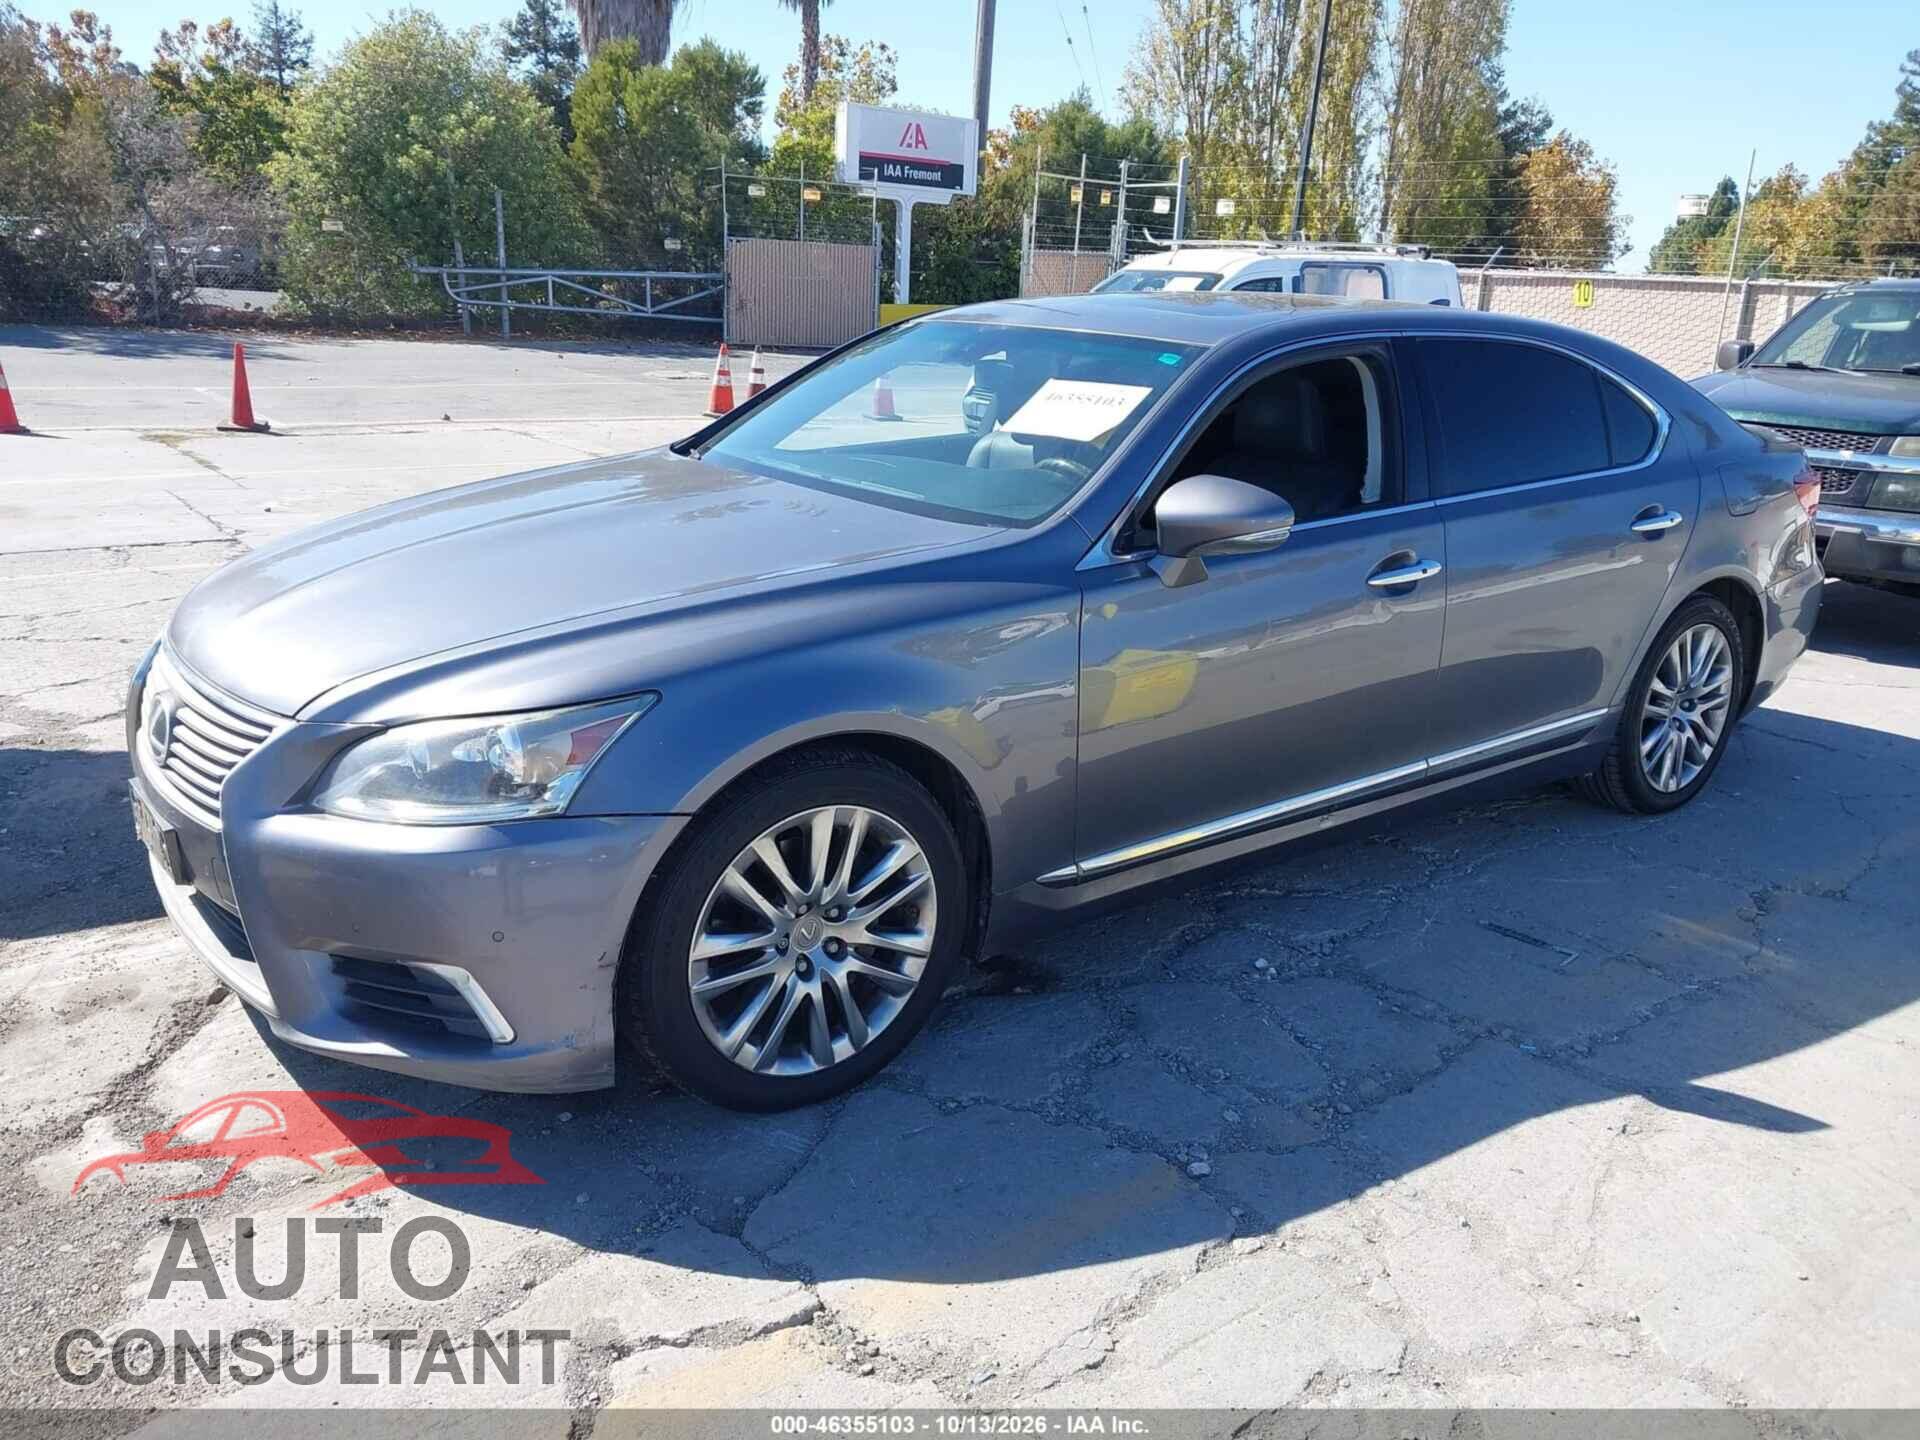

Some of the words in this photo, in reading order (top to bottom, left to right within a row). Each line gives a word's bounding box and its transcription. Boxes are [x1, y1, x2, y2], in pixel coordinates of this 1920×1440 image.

[883, 163, 902, 177] IAA
[904, 166, 942, 182] Fremont
[1577, 281, 1590, 303] 10
